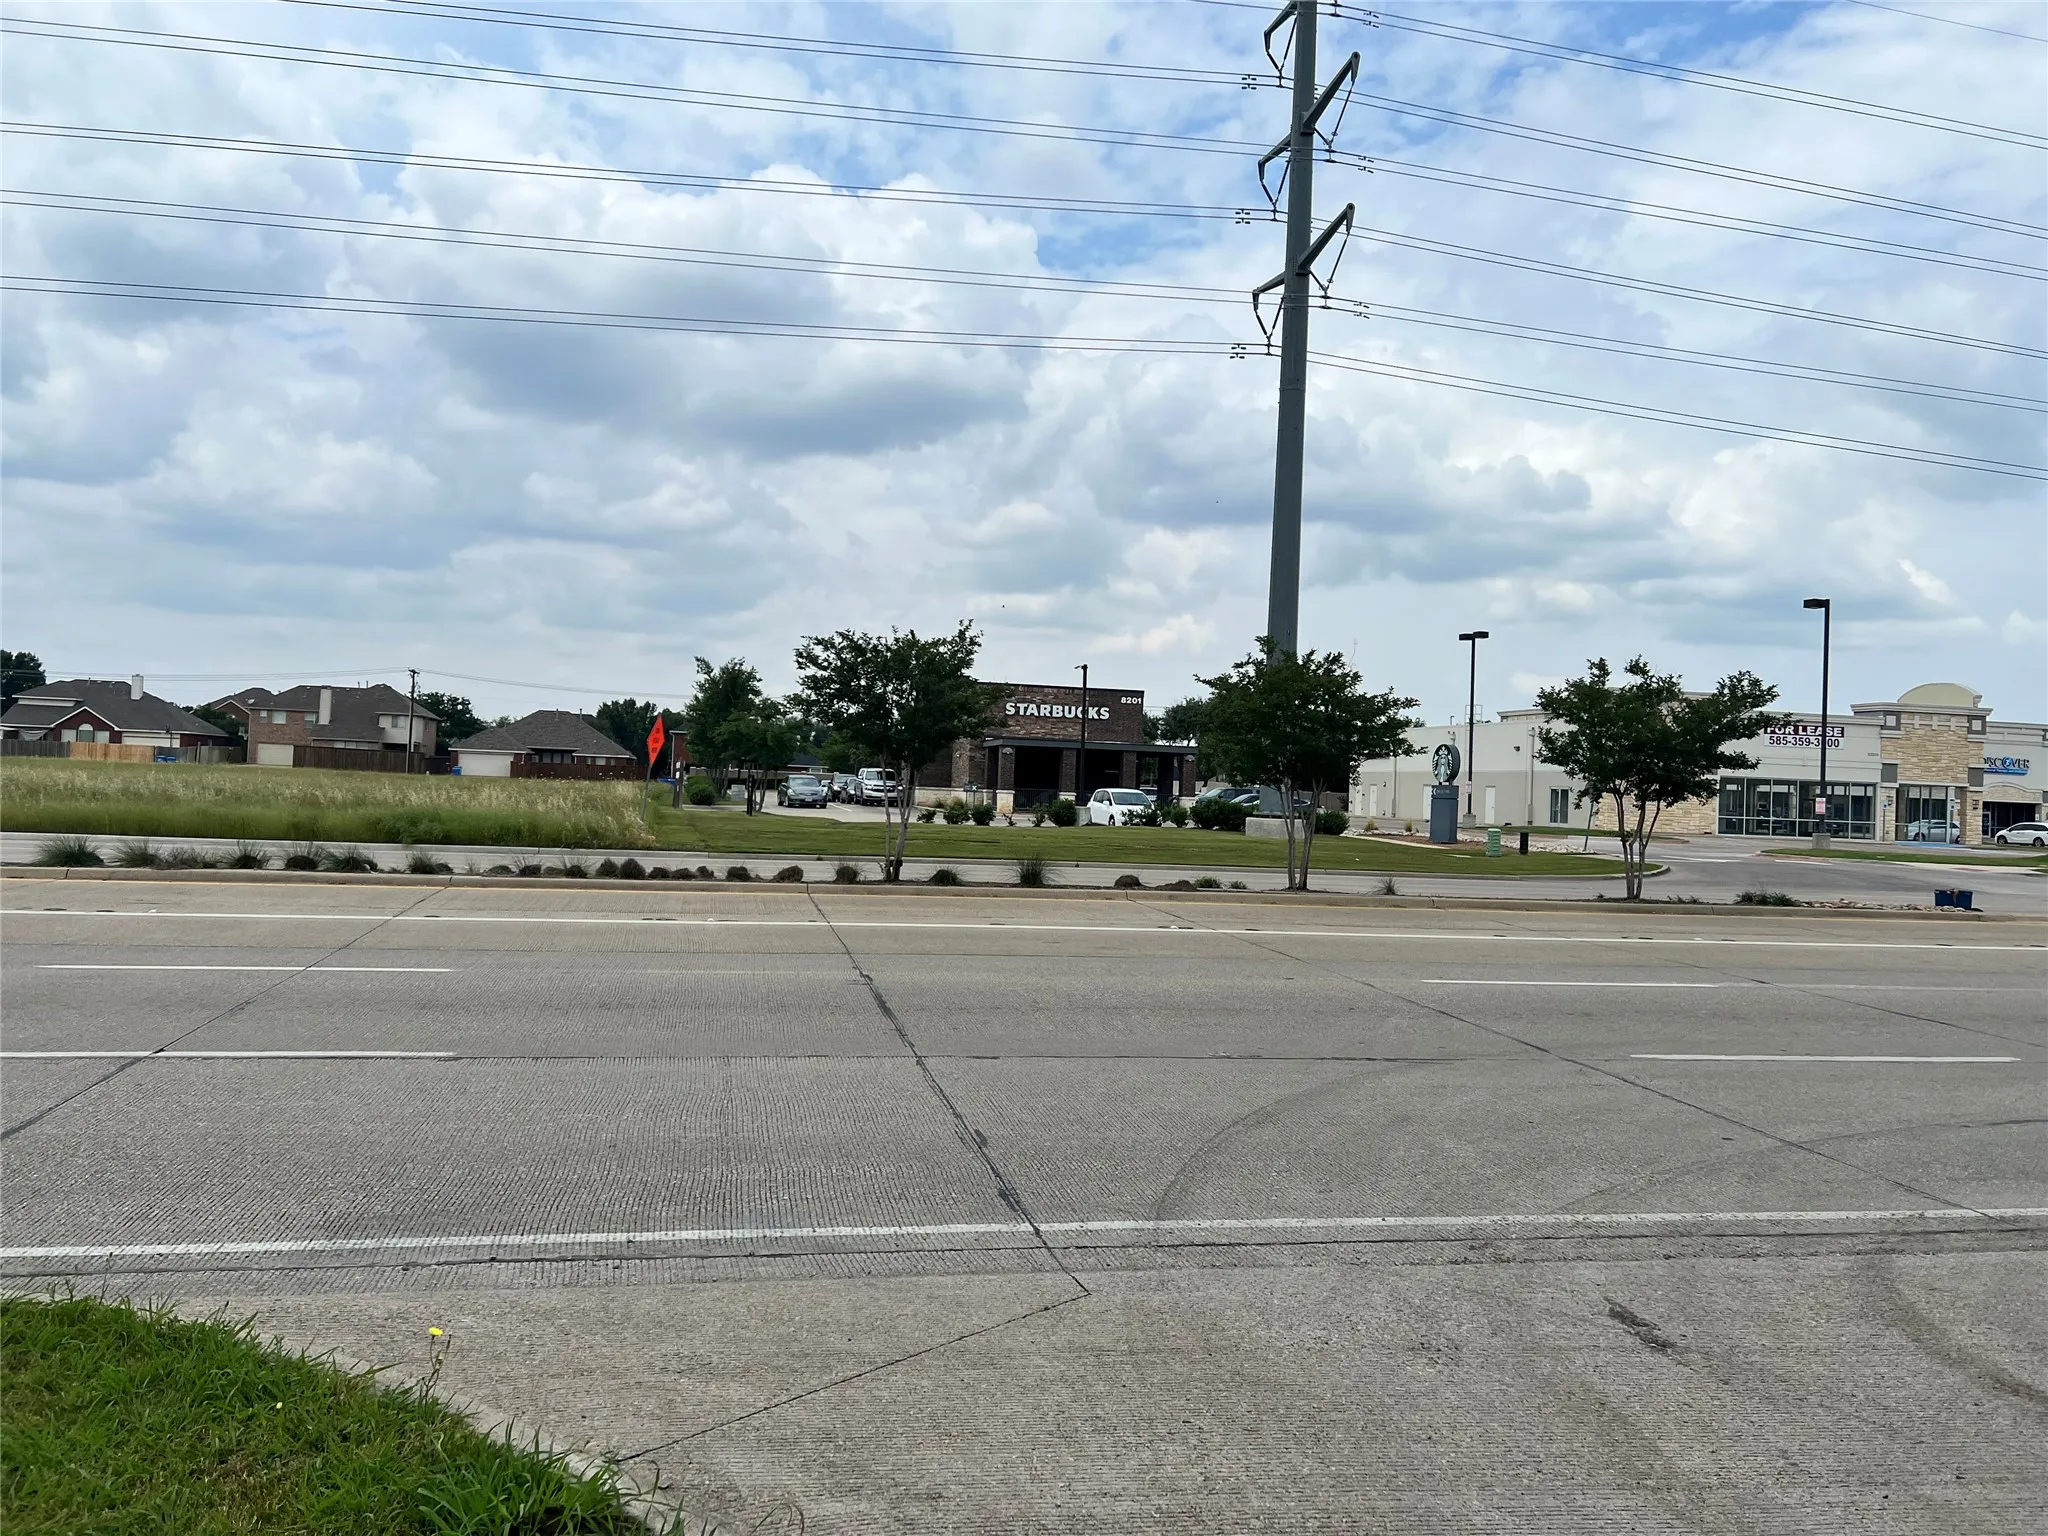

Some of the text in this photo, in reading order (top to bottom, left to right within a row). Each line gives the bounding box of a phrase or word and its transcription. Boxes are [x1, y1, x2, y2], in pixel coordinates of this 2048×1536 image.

[1120, 696, 1142, 704] 8201
[1005, 702, 1110, 720] STARBUCKS
[1766, 725, 1842, 737] FOR LEASE
[1769, 735, 1840, 748] 585-359-300
